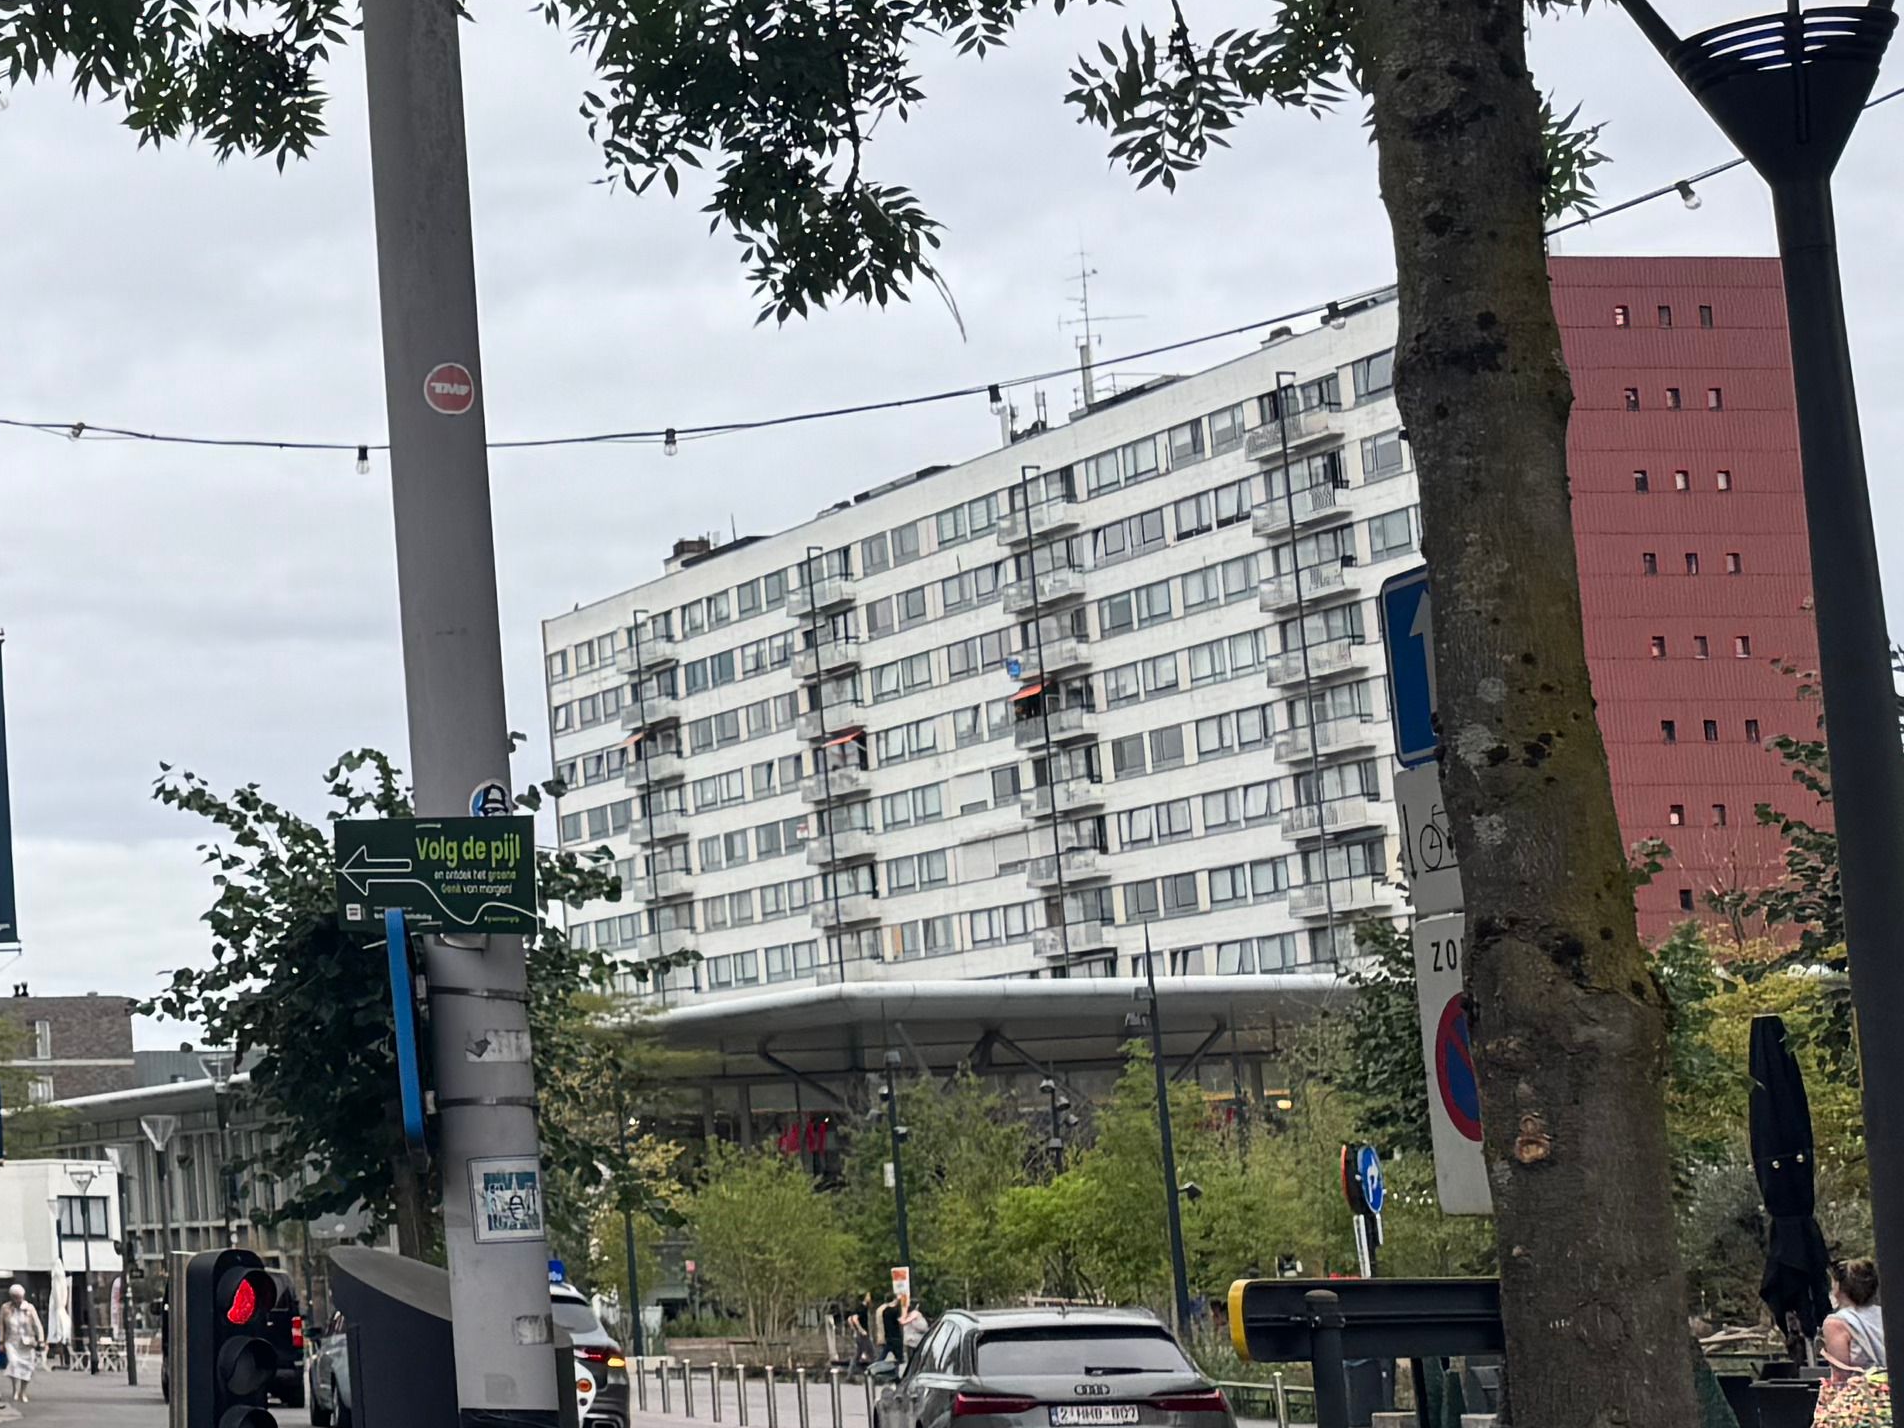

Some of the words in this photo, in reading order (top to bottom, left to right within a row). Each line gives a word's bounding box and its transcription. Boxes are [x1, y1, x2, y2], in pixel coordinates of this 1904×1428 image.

[415, 836, 458, 868] Volg
[462, 836, 487, 860] de
[491, 833, 521, 868] pijl
[1430, 937, 1463, 972] ZO
